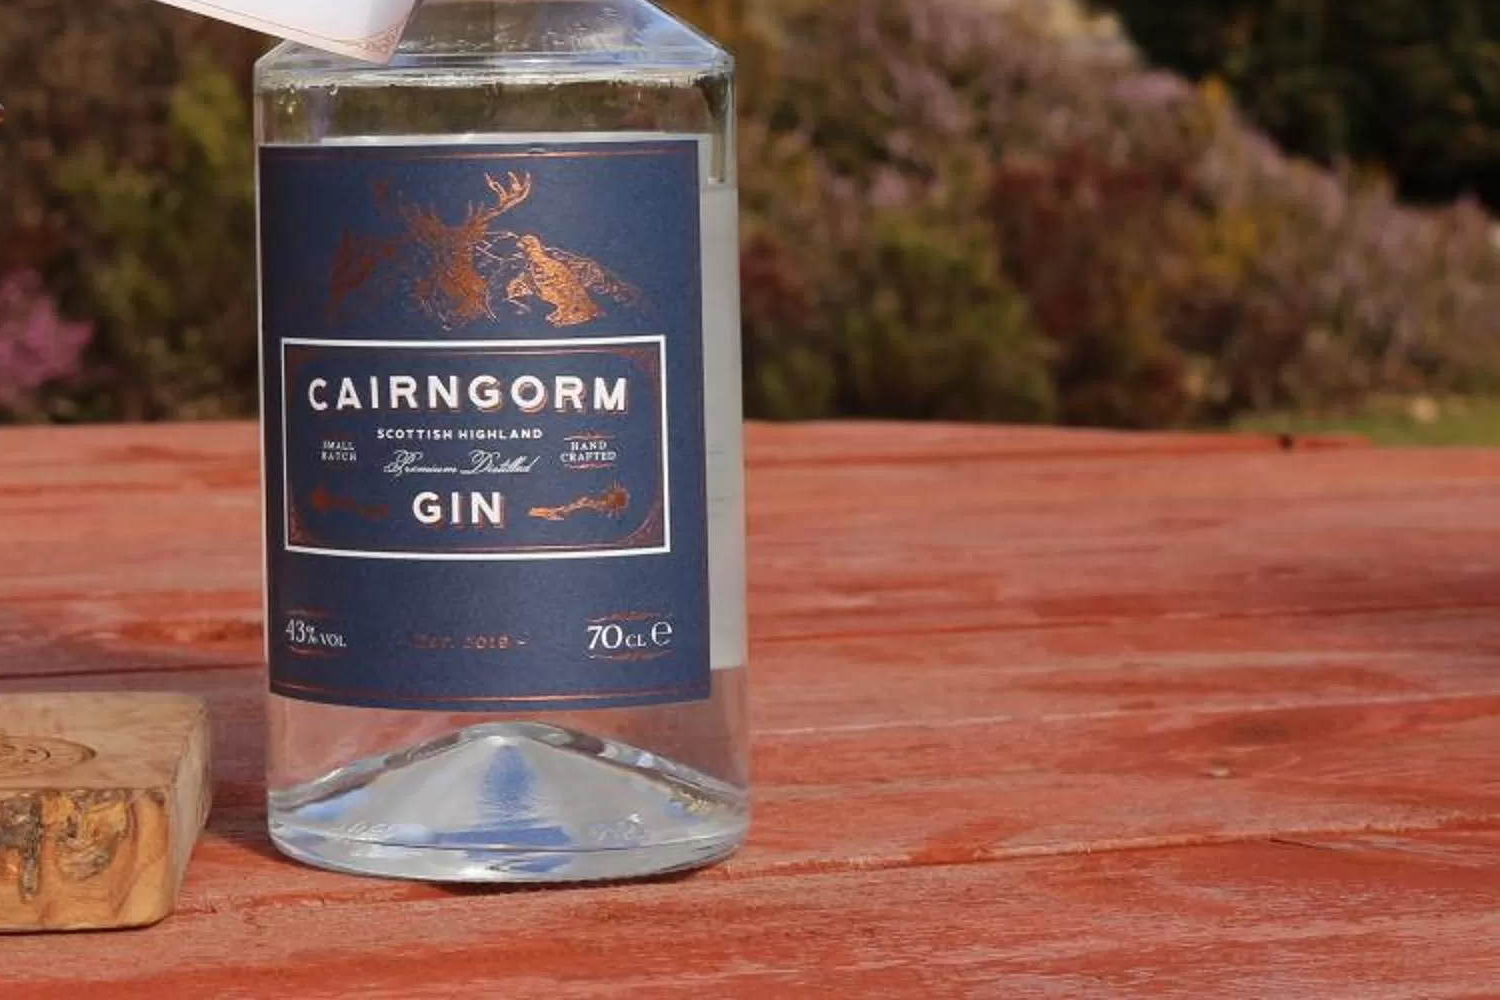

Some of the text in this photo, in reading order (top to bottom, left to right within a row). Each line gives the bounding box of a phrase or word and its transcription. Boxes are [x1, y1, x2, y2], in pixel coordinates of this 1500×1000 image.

[307, 374, 629, 412] CAIRNGORM
[377, 427, 543, 440] SCOTTISH HIGHLAND
[570, 441, 607, 450] HAND
[321, 451, 357, 461] BATCH
[383, 449, 541, 477] Premium Distilled
[559, 451, 617, 462] CRAFTED
[412, 491, 502, 525] GIN
[285, 618, 319, 645] 43%
